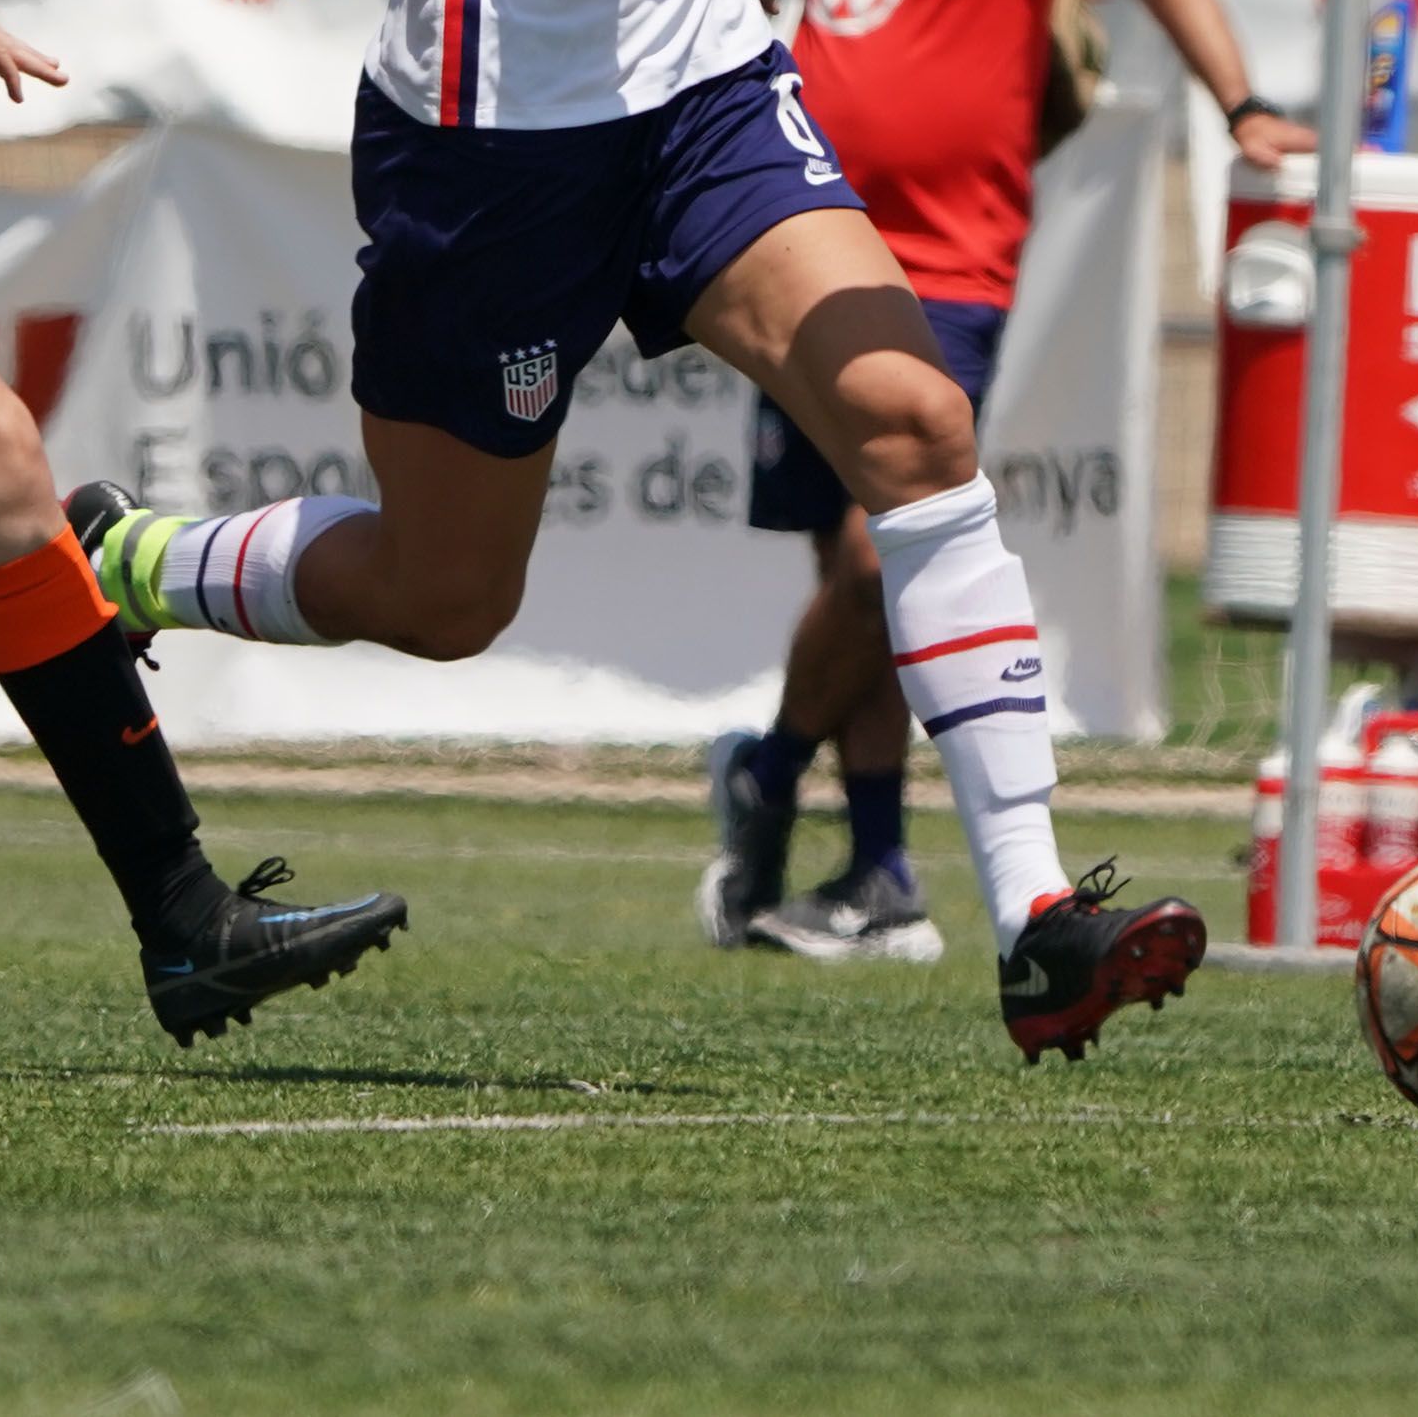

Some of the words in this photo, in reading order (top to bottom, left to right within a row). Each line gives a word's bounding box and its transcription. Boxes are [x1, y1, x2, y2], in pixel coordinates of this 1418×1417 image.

[130, 310, 340, 400] Unió
[506, 355, 553, 387] USA
[633, 430, 735, 522] de
